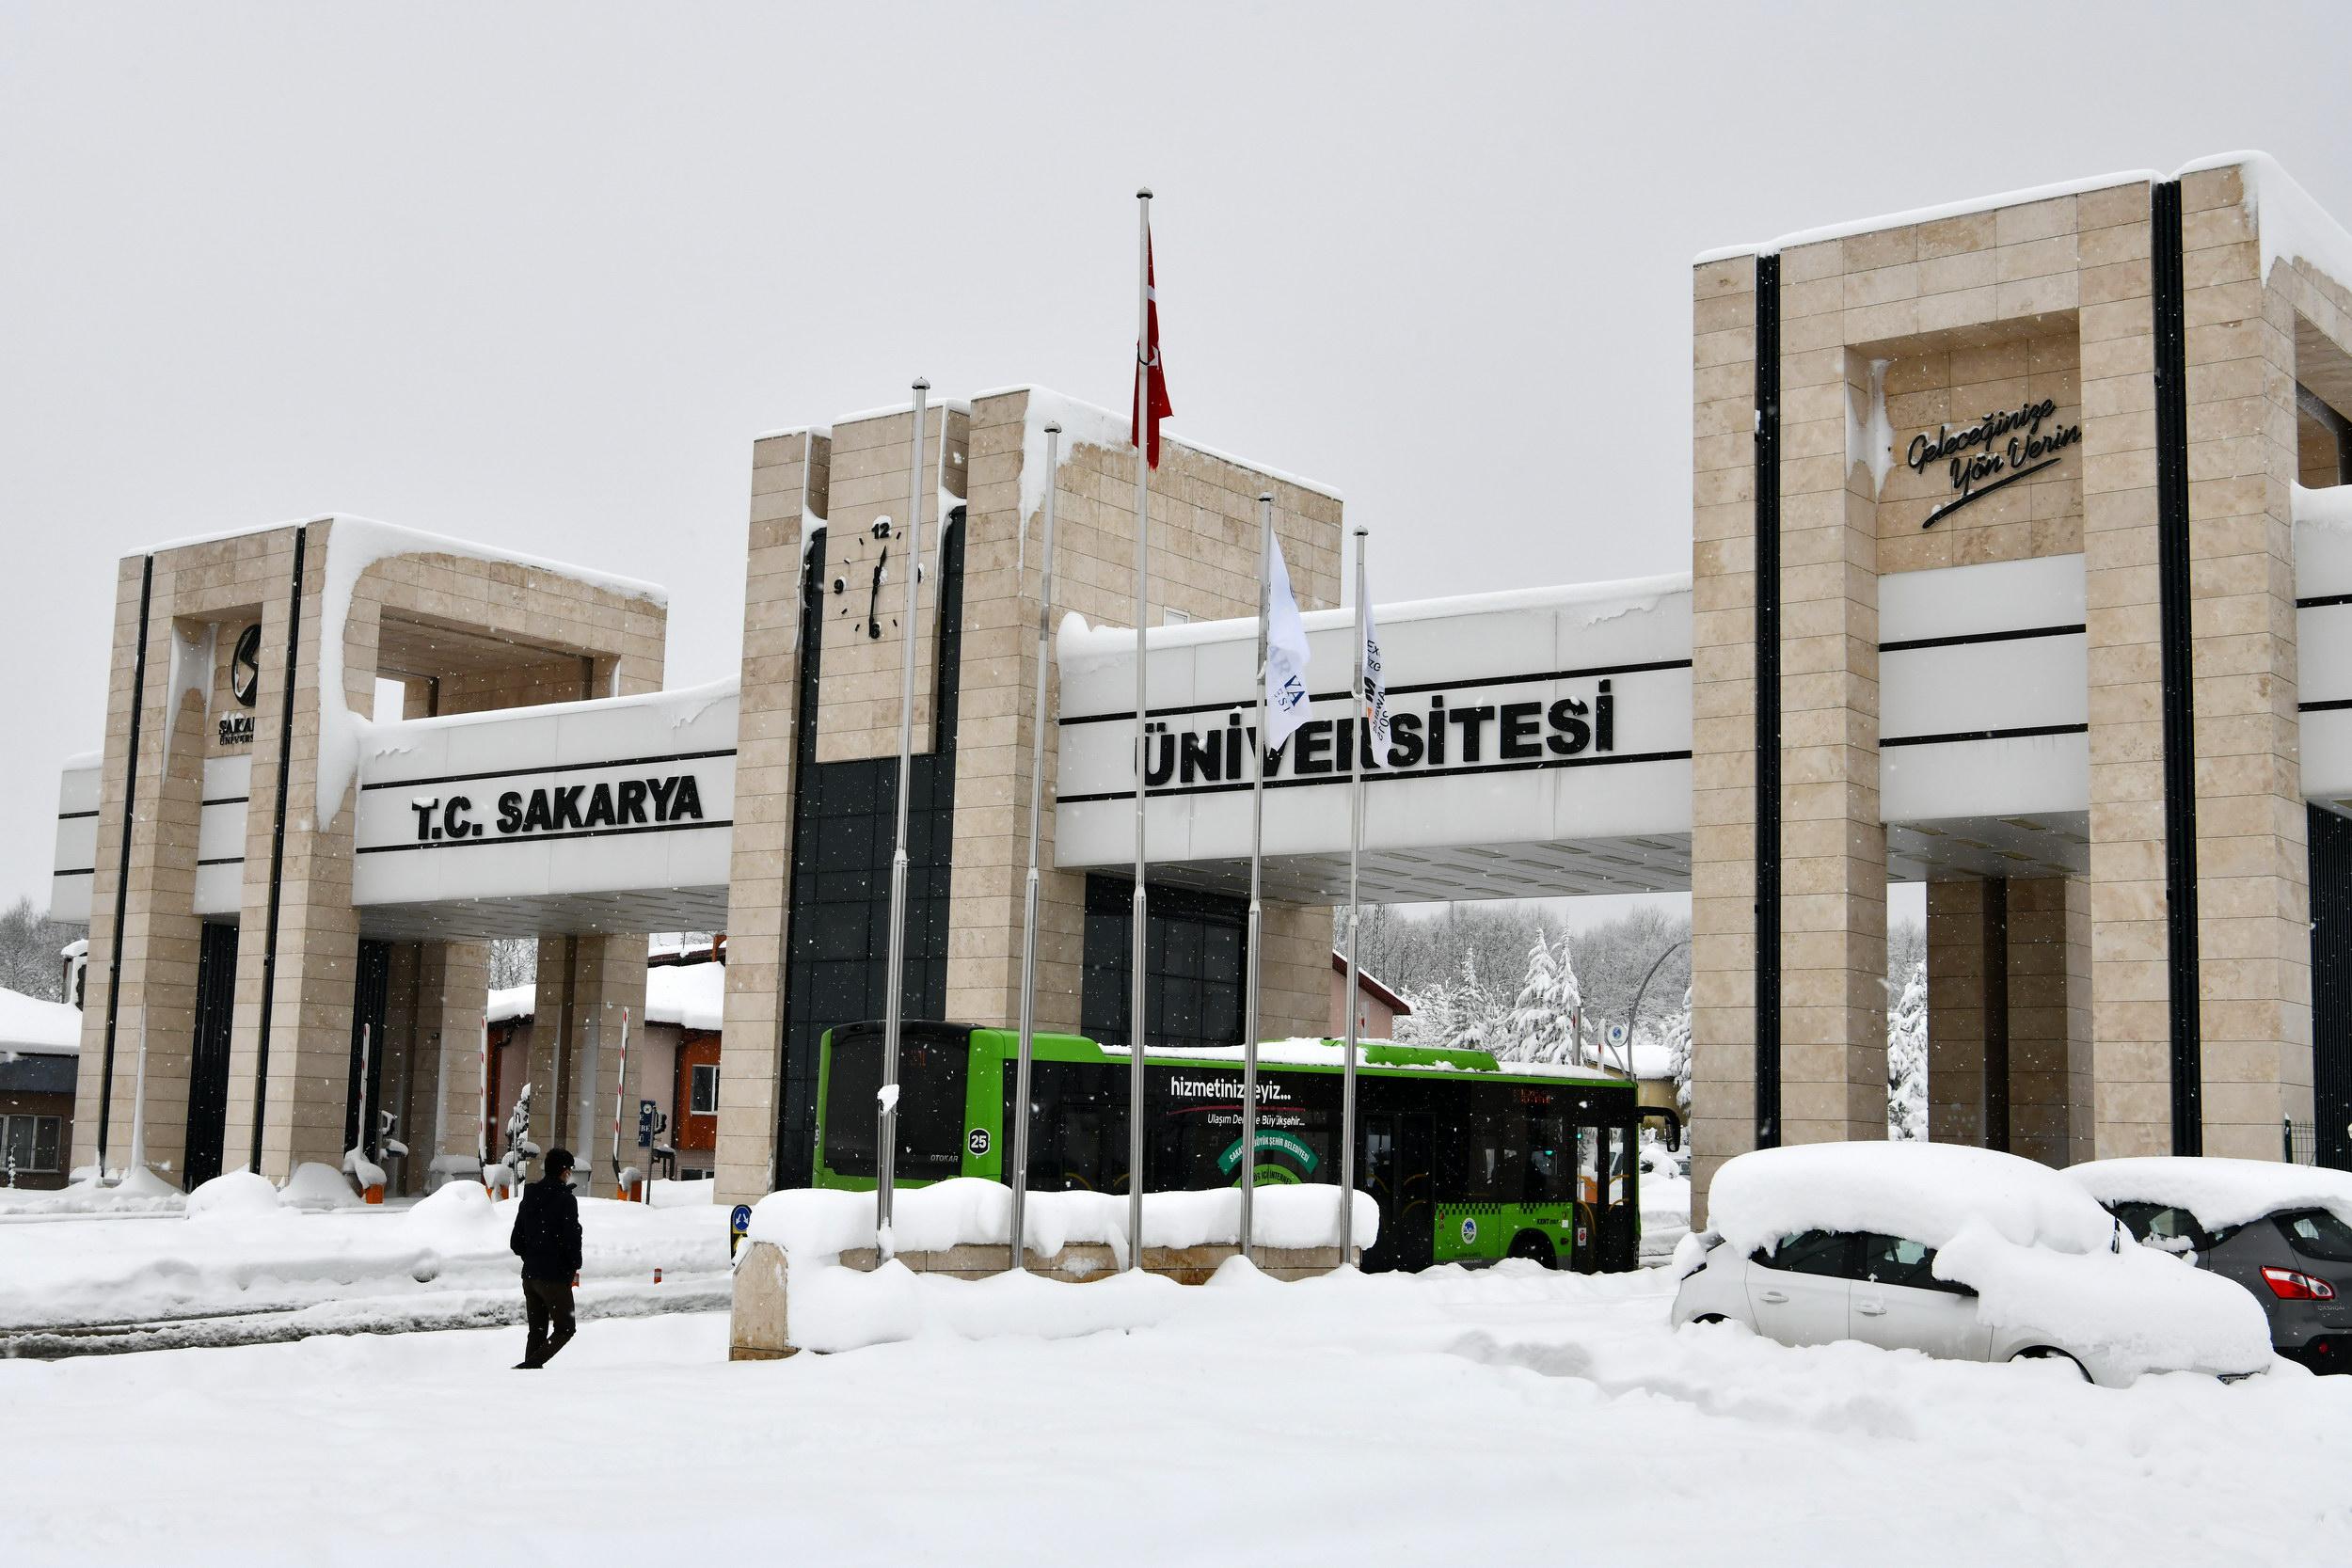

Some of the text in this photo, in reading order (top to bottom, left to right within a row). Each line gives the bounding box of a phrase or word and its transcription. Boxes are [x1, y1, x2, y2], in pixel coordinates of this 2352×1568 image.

[1908, 399, 2058, 474] Geleceğinize
[1949, 424, 2082, 496] Yön Verin
[871, 522, 890, 539] 12
[834, 579, 844, 594] 9
[412, 775, 703, 840] T.C. SAKARYA
[1170, 1076, 1291, 1103] hizmetinizeyiz...
[1207, 1114, 1232, 1127] Ulaşım
[970, 1134, 987, 1148] 25
[930, 1154, 959, 1163] OTOKAR
